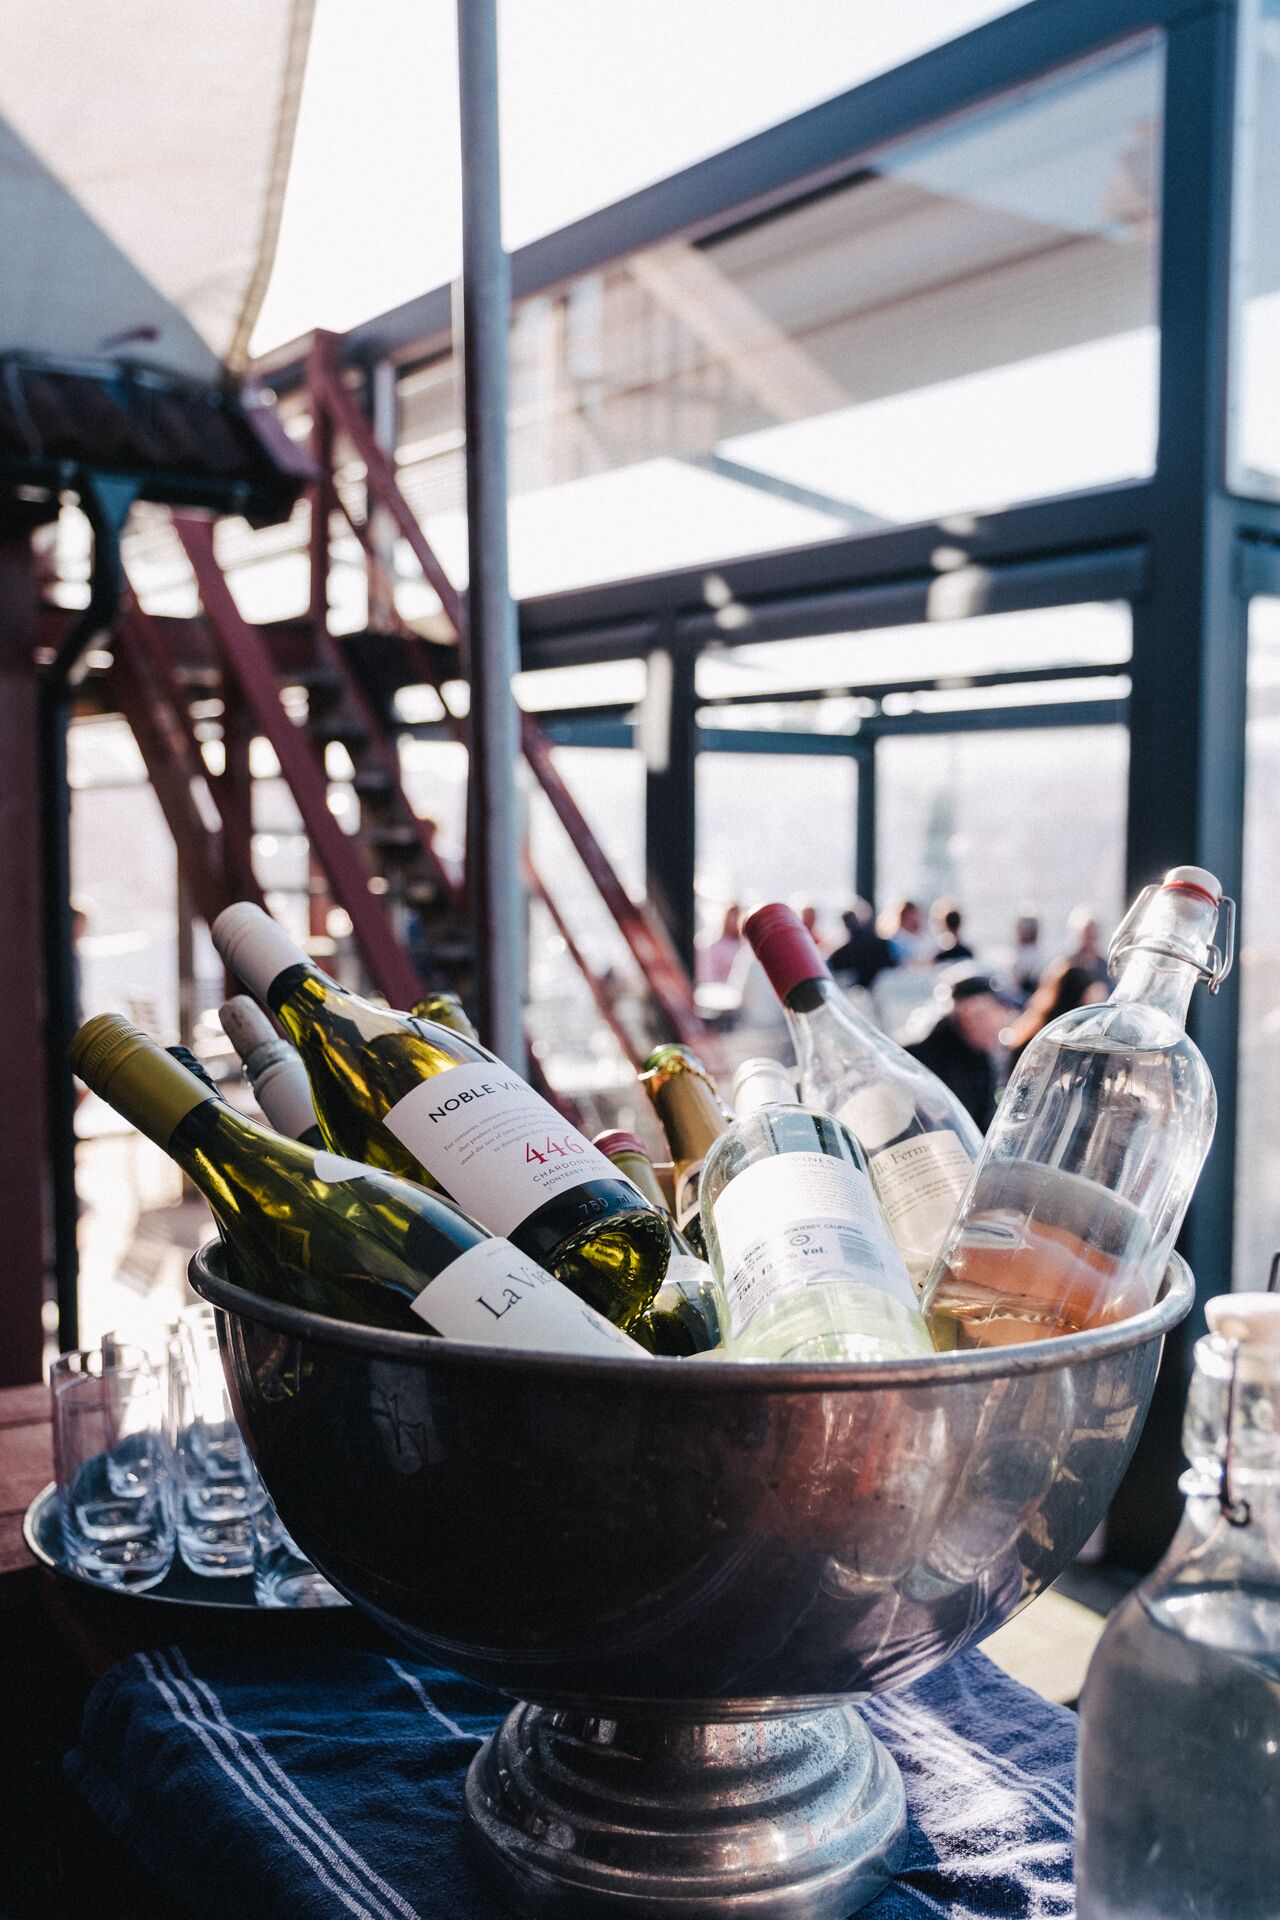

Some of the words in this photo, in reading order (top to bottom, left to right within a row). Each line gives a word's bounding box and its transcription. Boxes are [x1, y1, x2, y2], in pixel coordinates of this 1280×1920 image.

[428, 1083, 496, 1123] NOBLE
[526, 1135, 585, 1165] 446
[792, 1154, 835, 1166] VINES
[533, 1159, 602, 1182] CHARDONNAY
[543, 1167, 583, 1188] MONTEREY
[579, 1197, 609, 1215] 750
[824, 1223, 863, 1236] CALIFORNIA
[802, 1246, 828, 1256] Vol.
[475, 1288, 522, 1321] La
